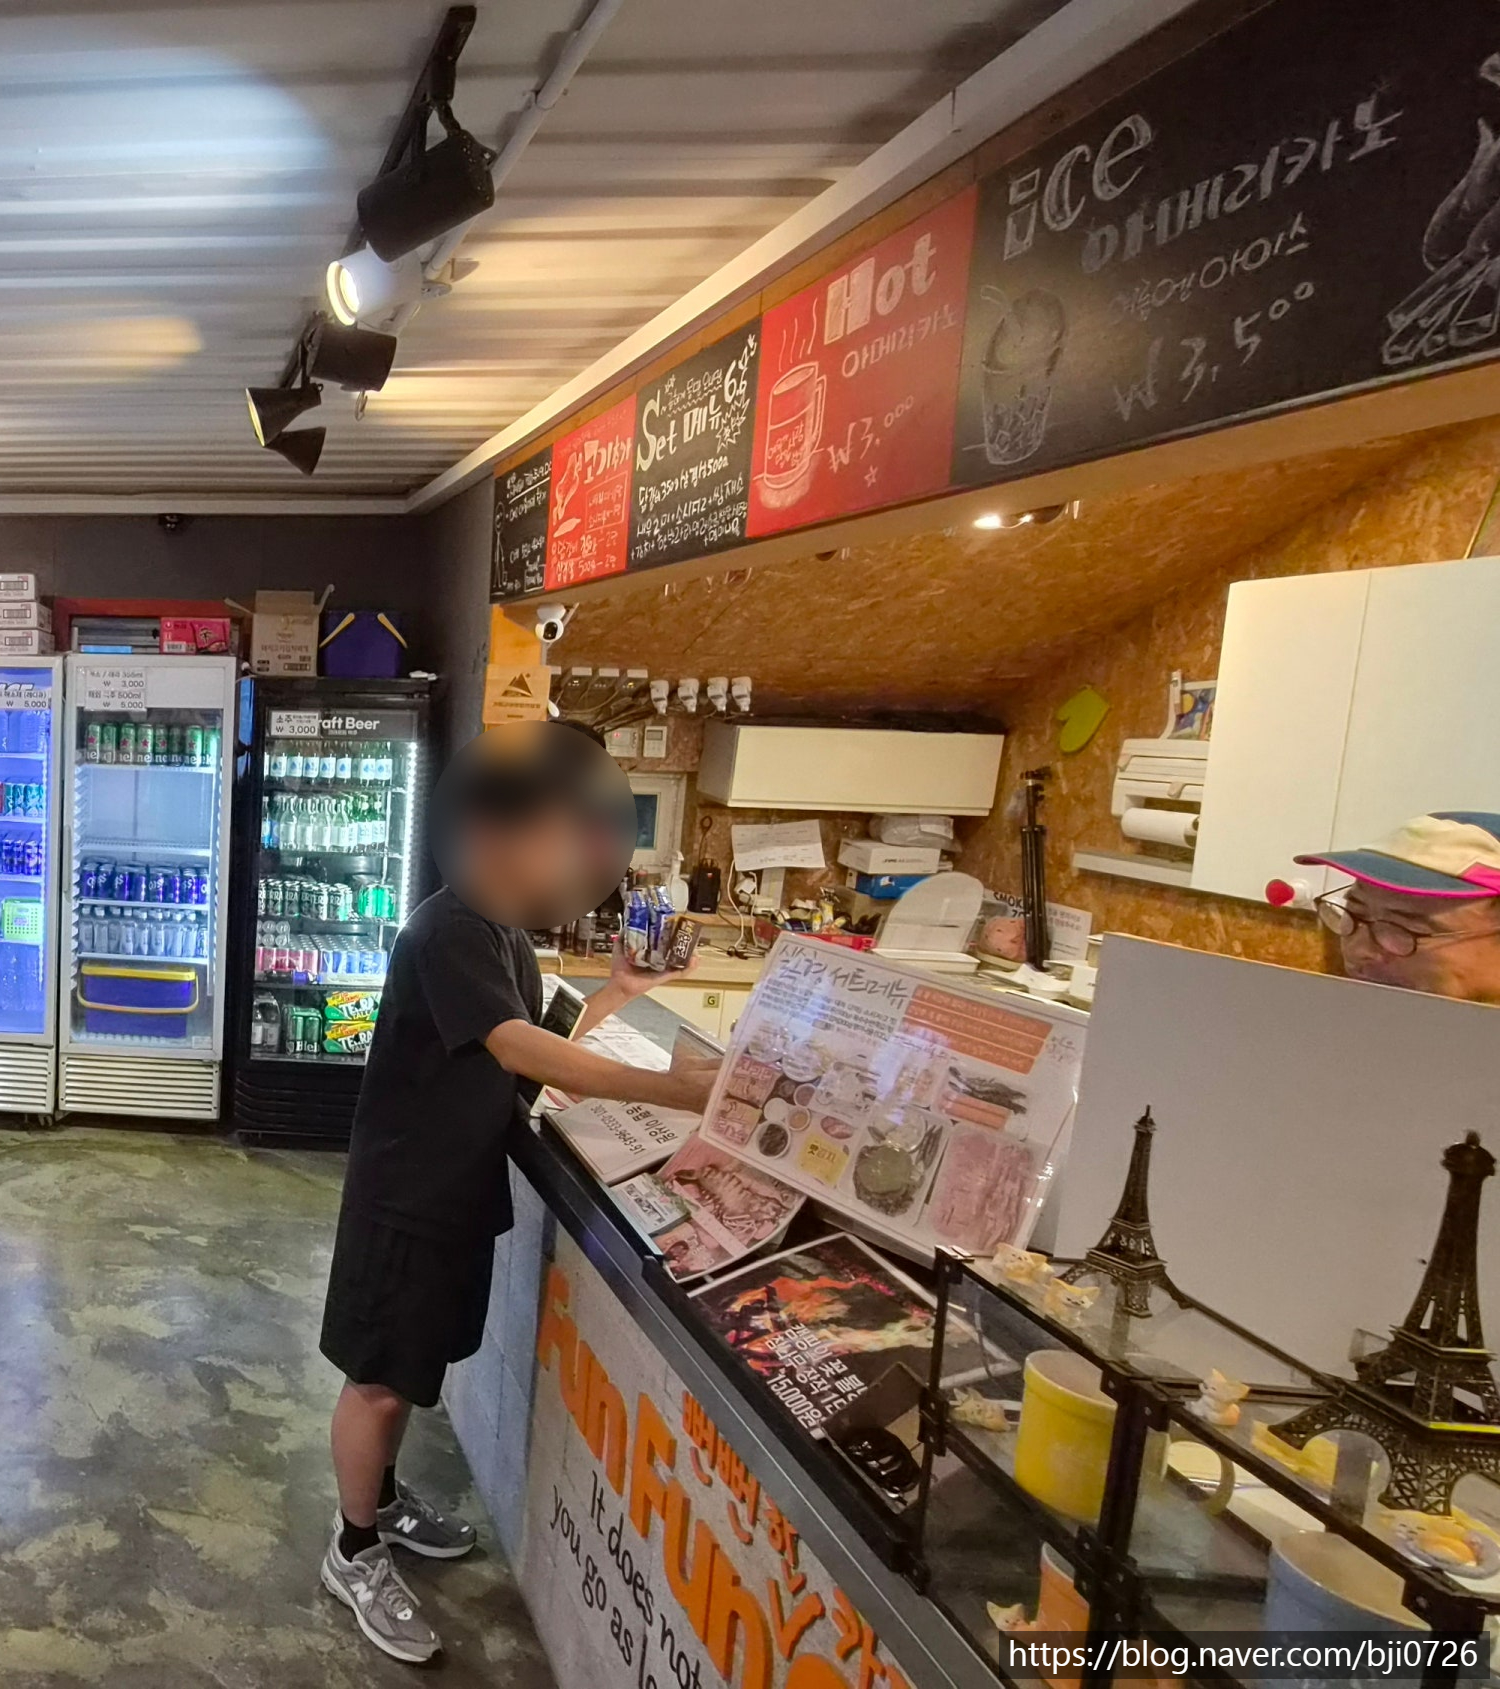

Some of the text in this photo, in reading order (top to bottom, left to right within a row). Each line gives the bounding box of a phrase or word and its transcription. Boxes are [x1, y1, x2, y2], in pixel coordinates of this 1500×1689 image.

[1081, 92, 1404, 274] 아메리카노
[1200, 212, 1309, 289] 아이스
[824, 233, 937, 345] Hot
[842, 303, 958, 379] 아메리카노
[636, 389, 678, 472] Set
[683, 394, 723, 444] 메뉴
[120, 701, 143, 709] 5,000
[121, 680, 144, 688] 3,000
[289, 726, 316, 735] 3,000
[319, 716, 345, 730] raft
[345, 717, 380, 730] Beer
[765, 1334, 808, 1369] 참나무
[796, 1367, 832, 1395] 장작
[785, 1322, 833, 1361] 캠핑의
[819, 1359, 848, 1377] 꽃
[537, 1265, 773, 1689] Fun Fun
[396, 1515, 418, 1533] N
[590, 1470, 605, 1536] It
[607, 1513, 656, 1627] does
[350, 1581, 373, 1603] N
[549, 1484, 582, 1567] you
[581, 1553, 607, 1612] go
[610, 1606, 634, 1667] as
